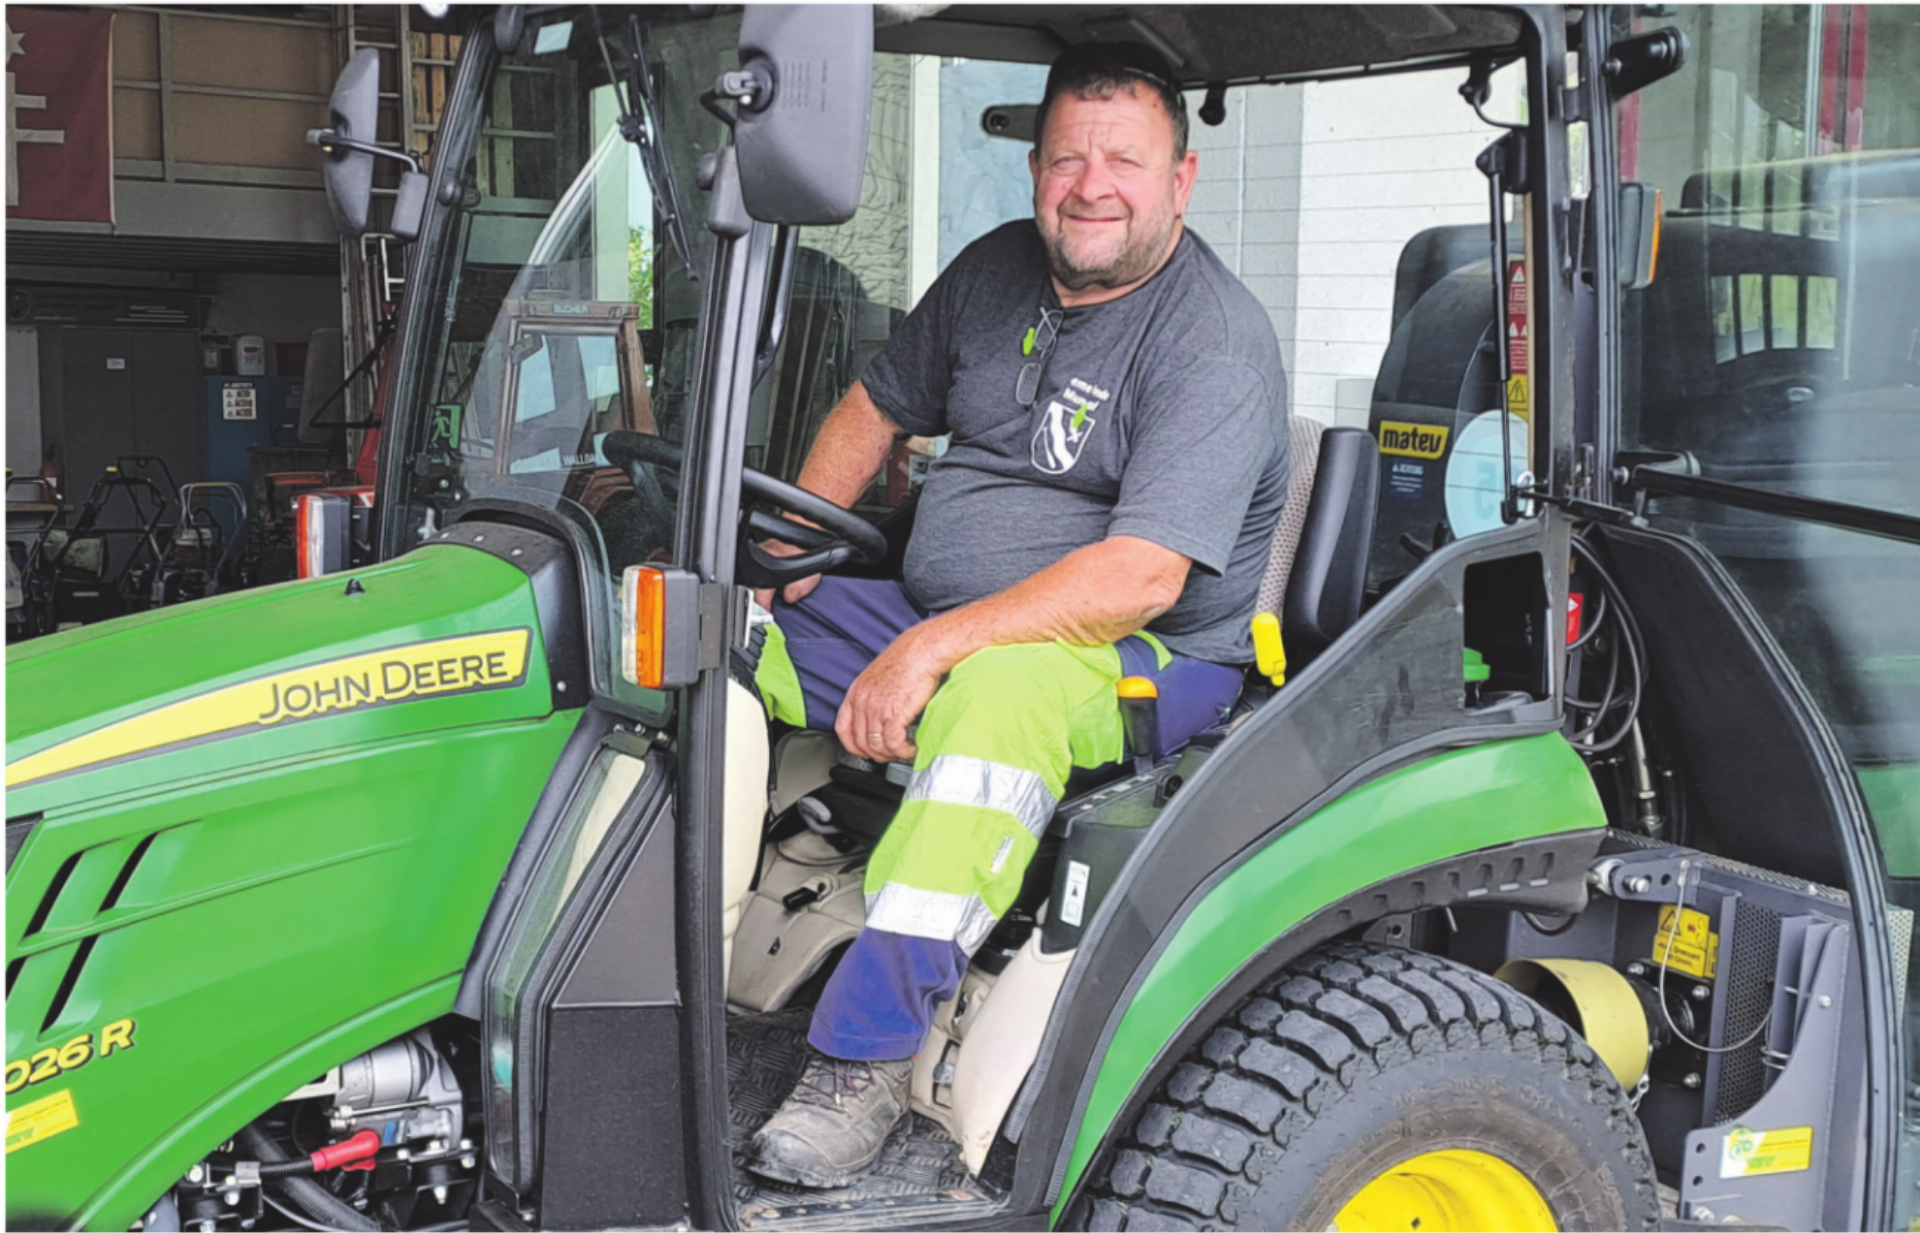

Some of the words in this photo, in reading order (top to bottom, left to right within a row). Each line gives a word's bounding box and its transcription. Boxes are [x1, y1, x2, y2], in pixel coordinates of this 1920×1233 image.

[1383, 426, 1442, 453] matev
[259, 673, 371, 720] JOHN
[381, 651, 508, 695] DEERE
[99, 1018, 136, 1058] R
